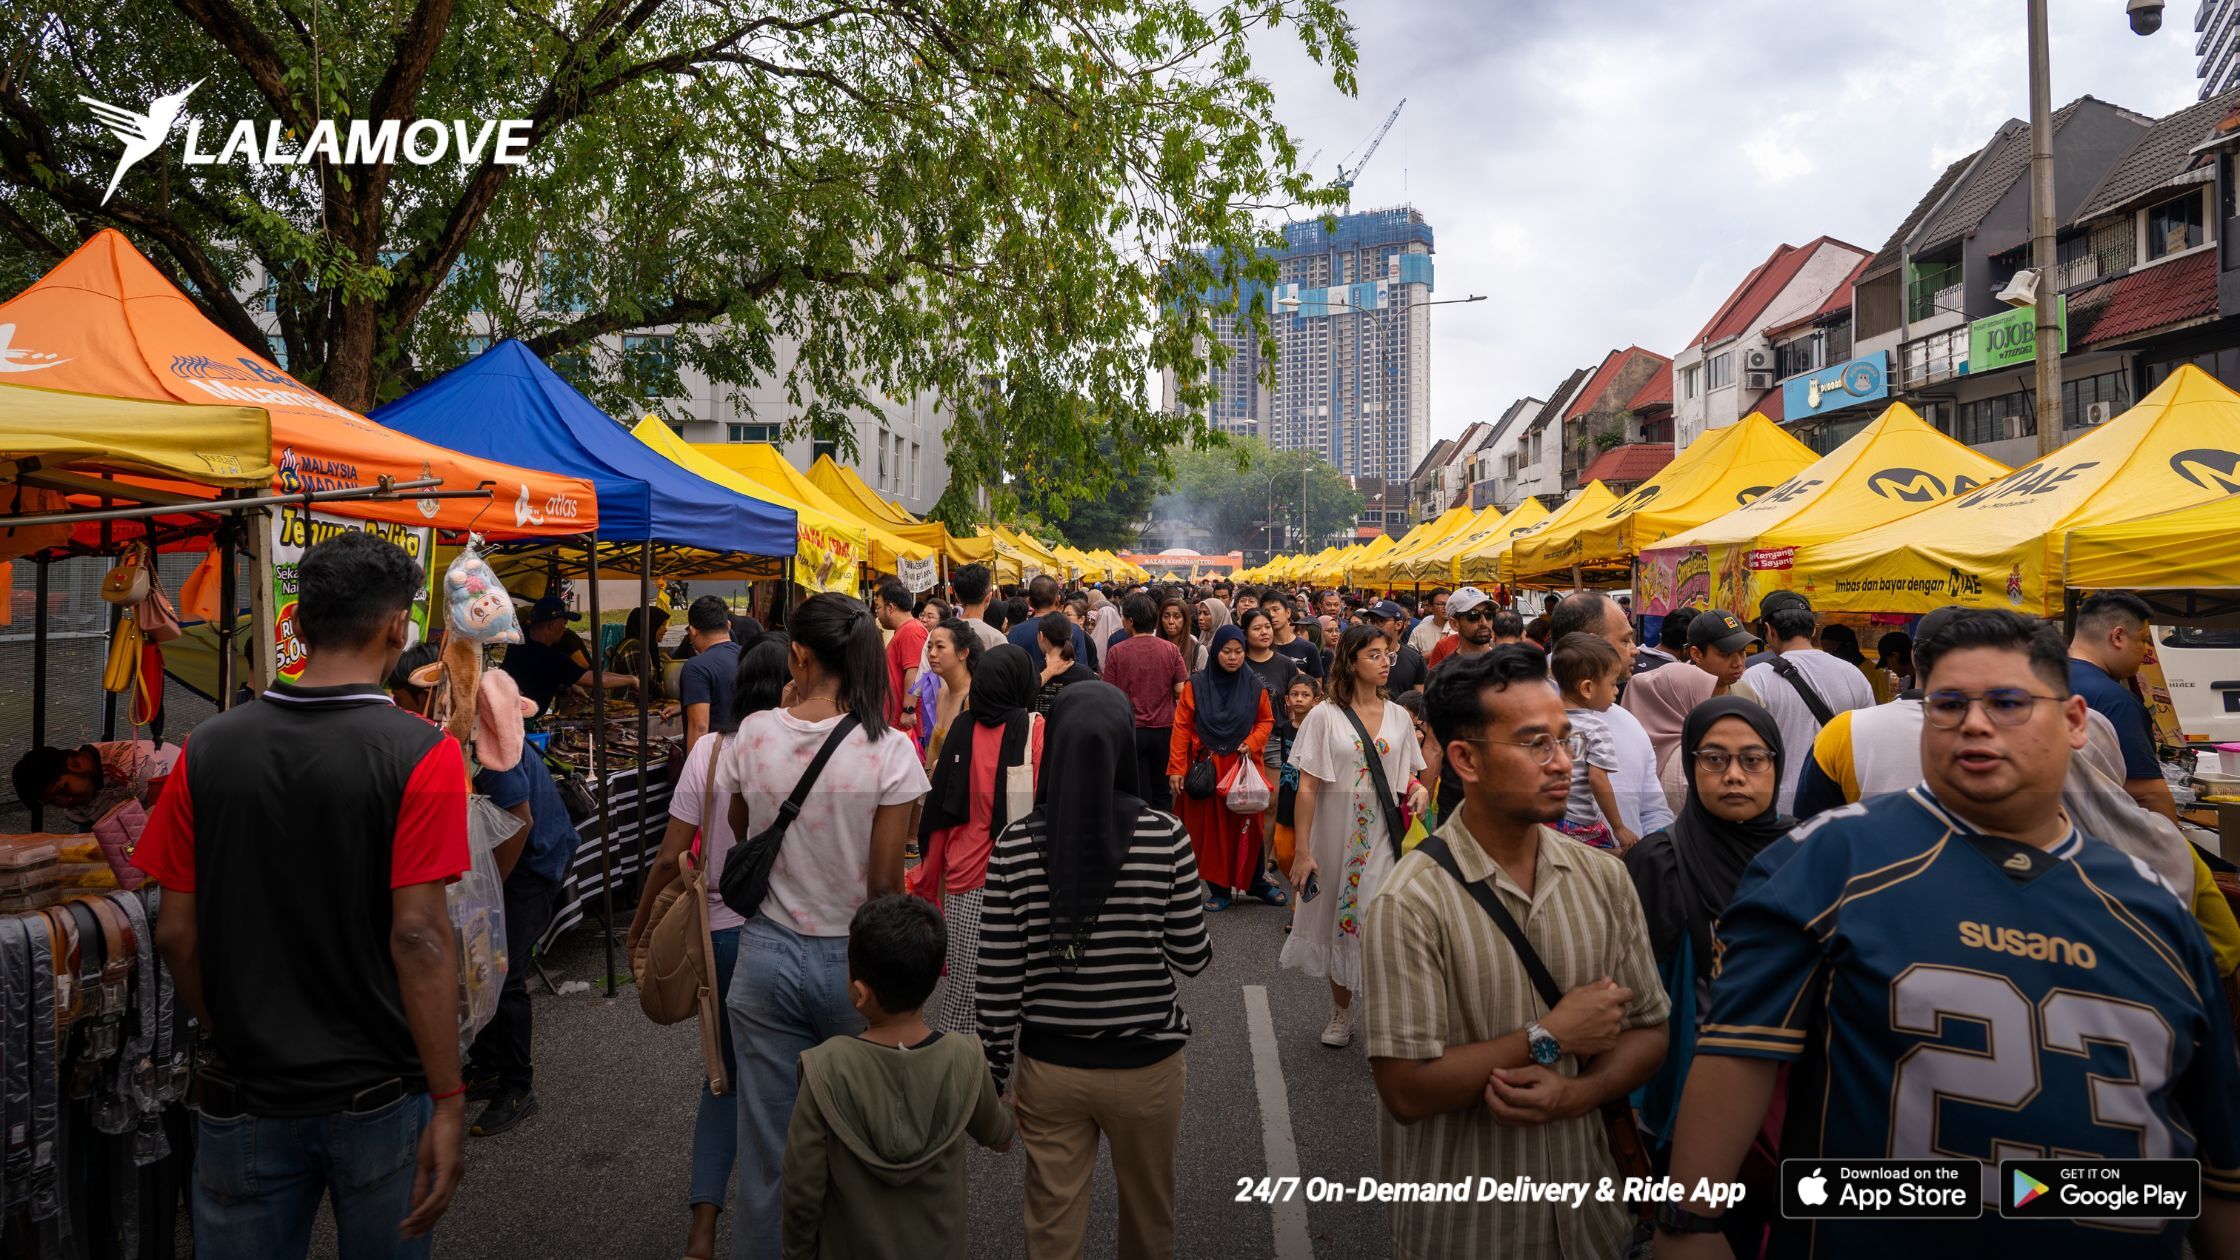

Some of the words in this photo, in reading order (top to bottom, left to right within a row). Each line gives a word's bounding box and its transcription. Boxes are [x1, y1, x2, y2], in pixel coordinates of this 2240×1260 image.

[1986, 320, 2036, 352] JOJOB
[301, 456, 358, 480] MALAYSIA
[545, 493, 578, 518] atlas
[1835, 578, 1861, 592] Imbas
[1862, 577, 1878, 591] dan
[1879, 577, 1905, 595] bayar
[1907, 576, 1945, 596] dengan
[1948, 567, 1983, 598] MAE
[1887, 963, 2177, 1234] 23
